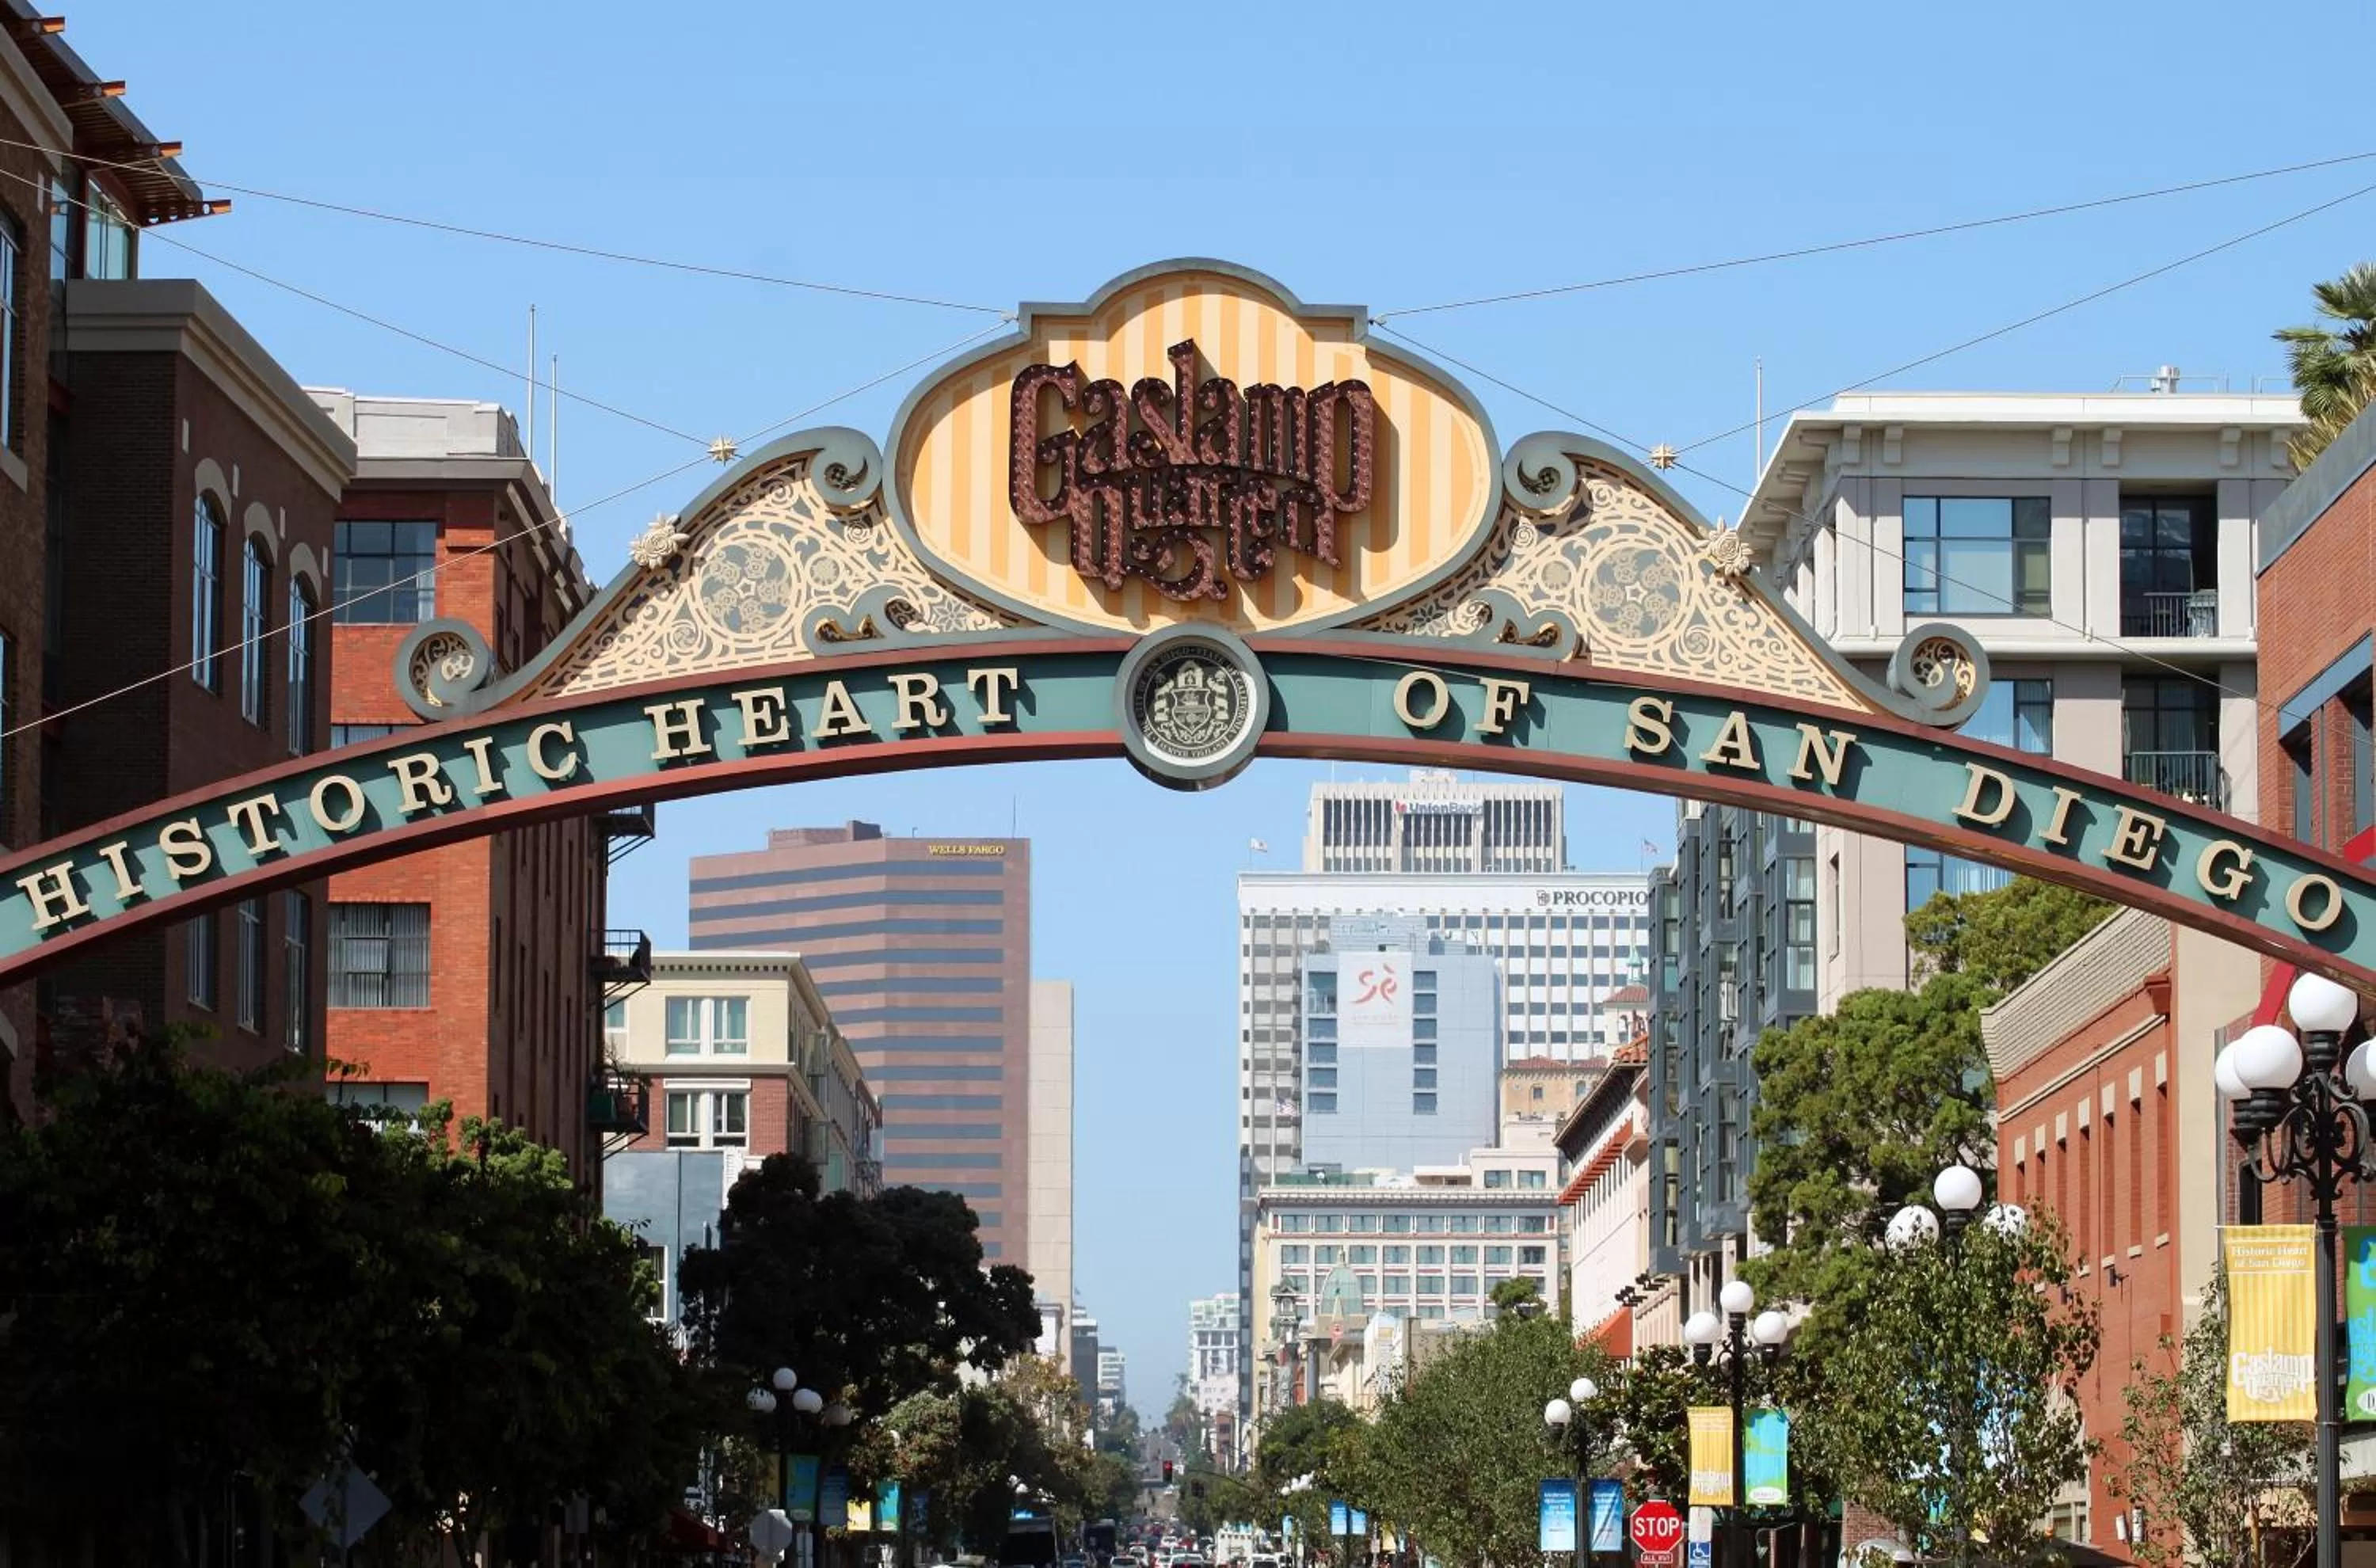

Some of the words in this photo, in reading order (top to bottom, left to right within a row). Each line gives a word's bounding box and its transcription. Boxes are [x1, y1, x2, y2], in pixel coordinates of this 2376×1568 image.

[1009, 338, 1374, 523] Gaslamp
[1070, 466, 1342, 601] Quarter
[16, 721, 578, 931] HISTORIC
[643, 667, 1019, 761] HEART
[1393, 670, 1531, 734] OF
[1624, 696, 1856, 785] SAN
[1951, 762, 2342, 931] DIEGO
[928, 845, 965, 854] WELLS
[969, 845, 1004, 854] FARGO
[1553, 890, 1647, 907] PROCOPIO
[2231, 1346, 2314, 1387] Gaslamp
[1635, 1517, 1680, 1537] STOP
